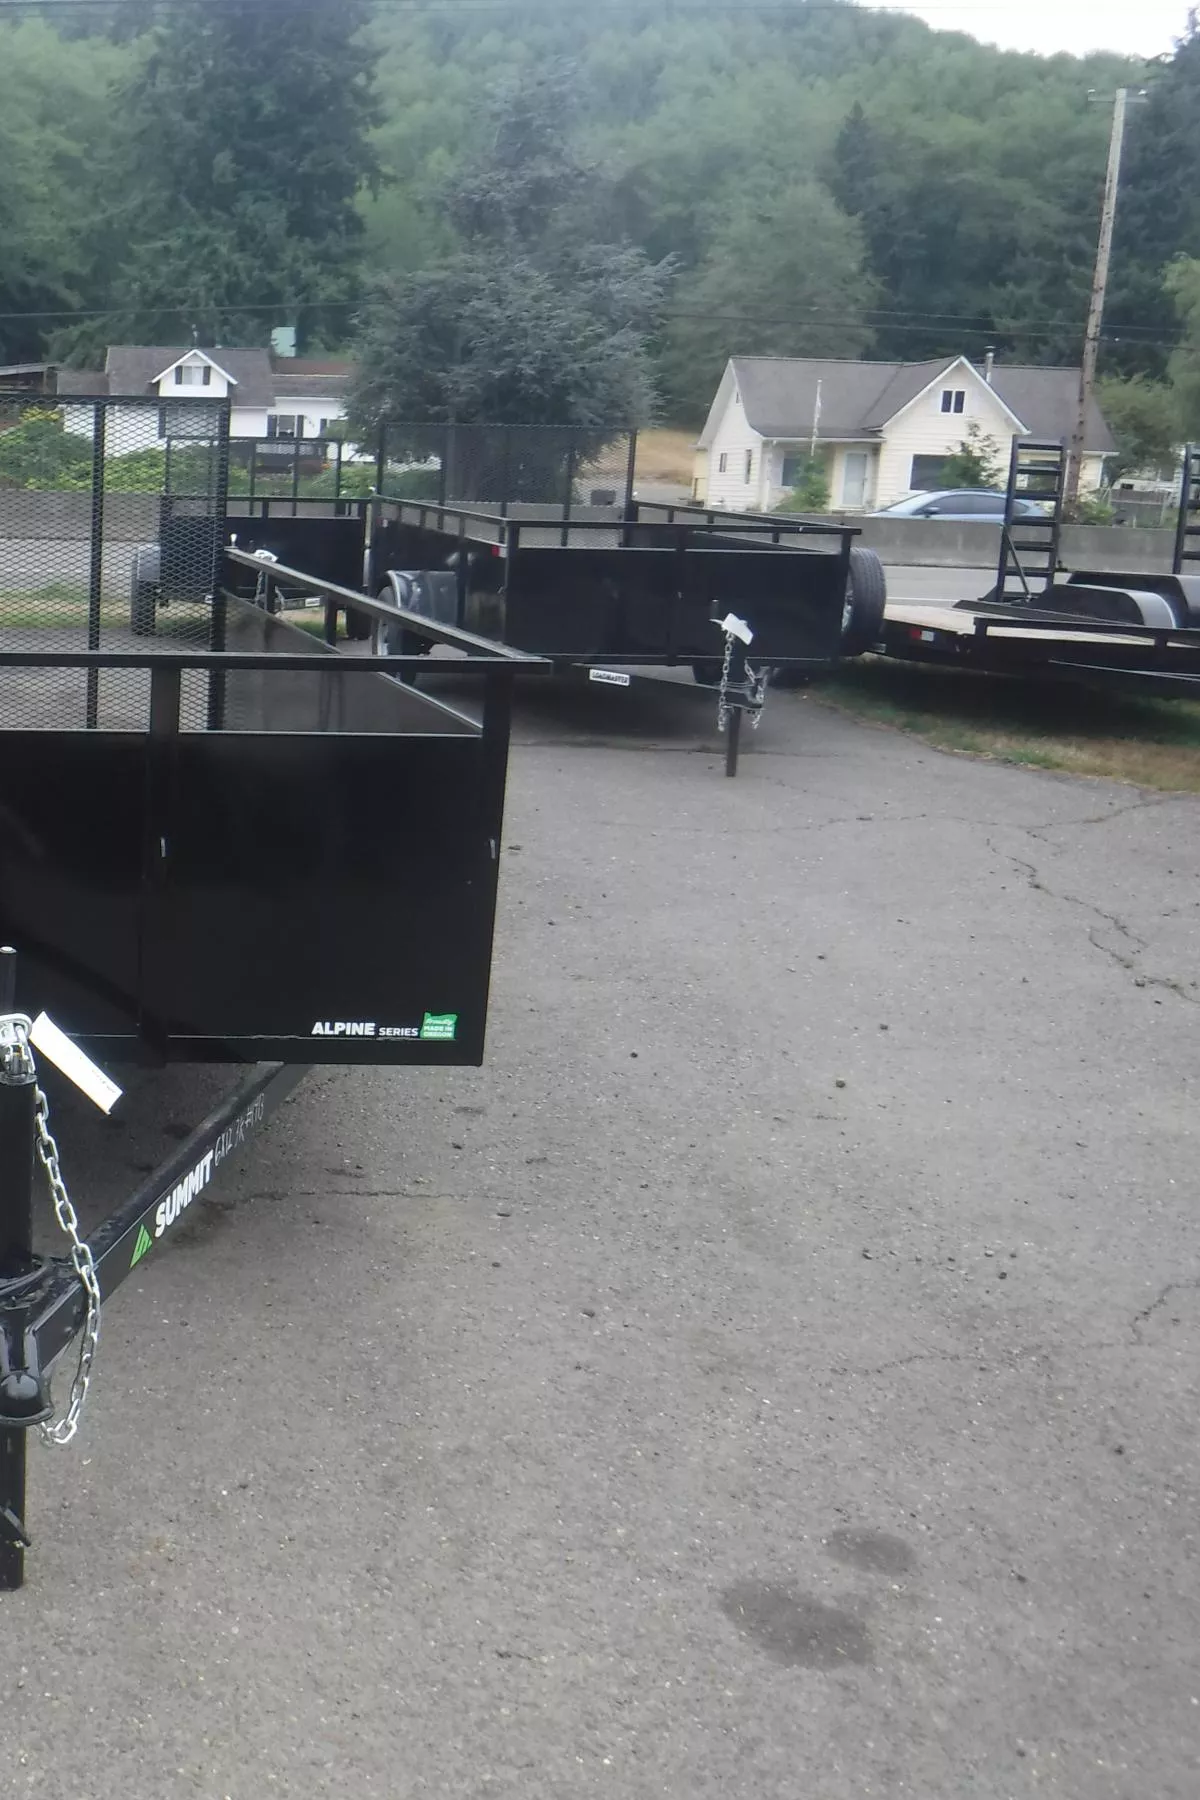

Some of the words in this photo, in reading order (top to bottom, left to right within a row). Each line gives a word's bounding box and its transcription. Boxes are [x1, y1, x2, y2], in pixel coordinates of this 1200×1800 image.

[311, 1021, 376, 1036] ALPINE
[378, 1027, 419, 1037] SERIES
[155, 1150, 213, 1238] SUMMIT
